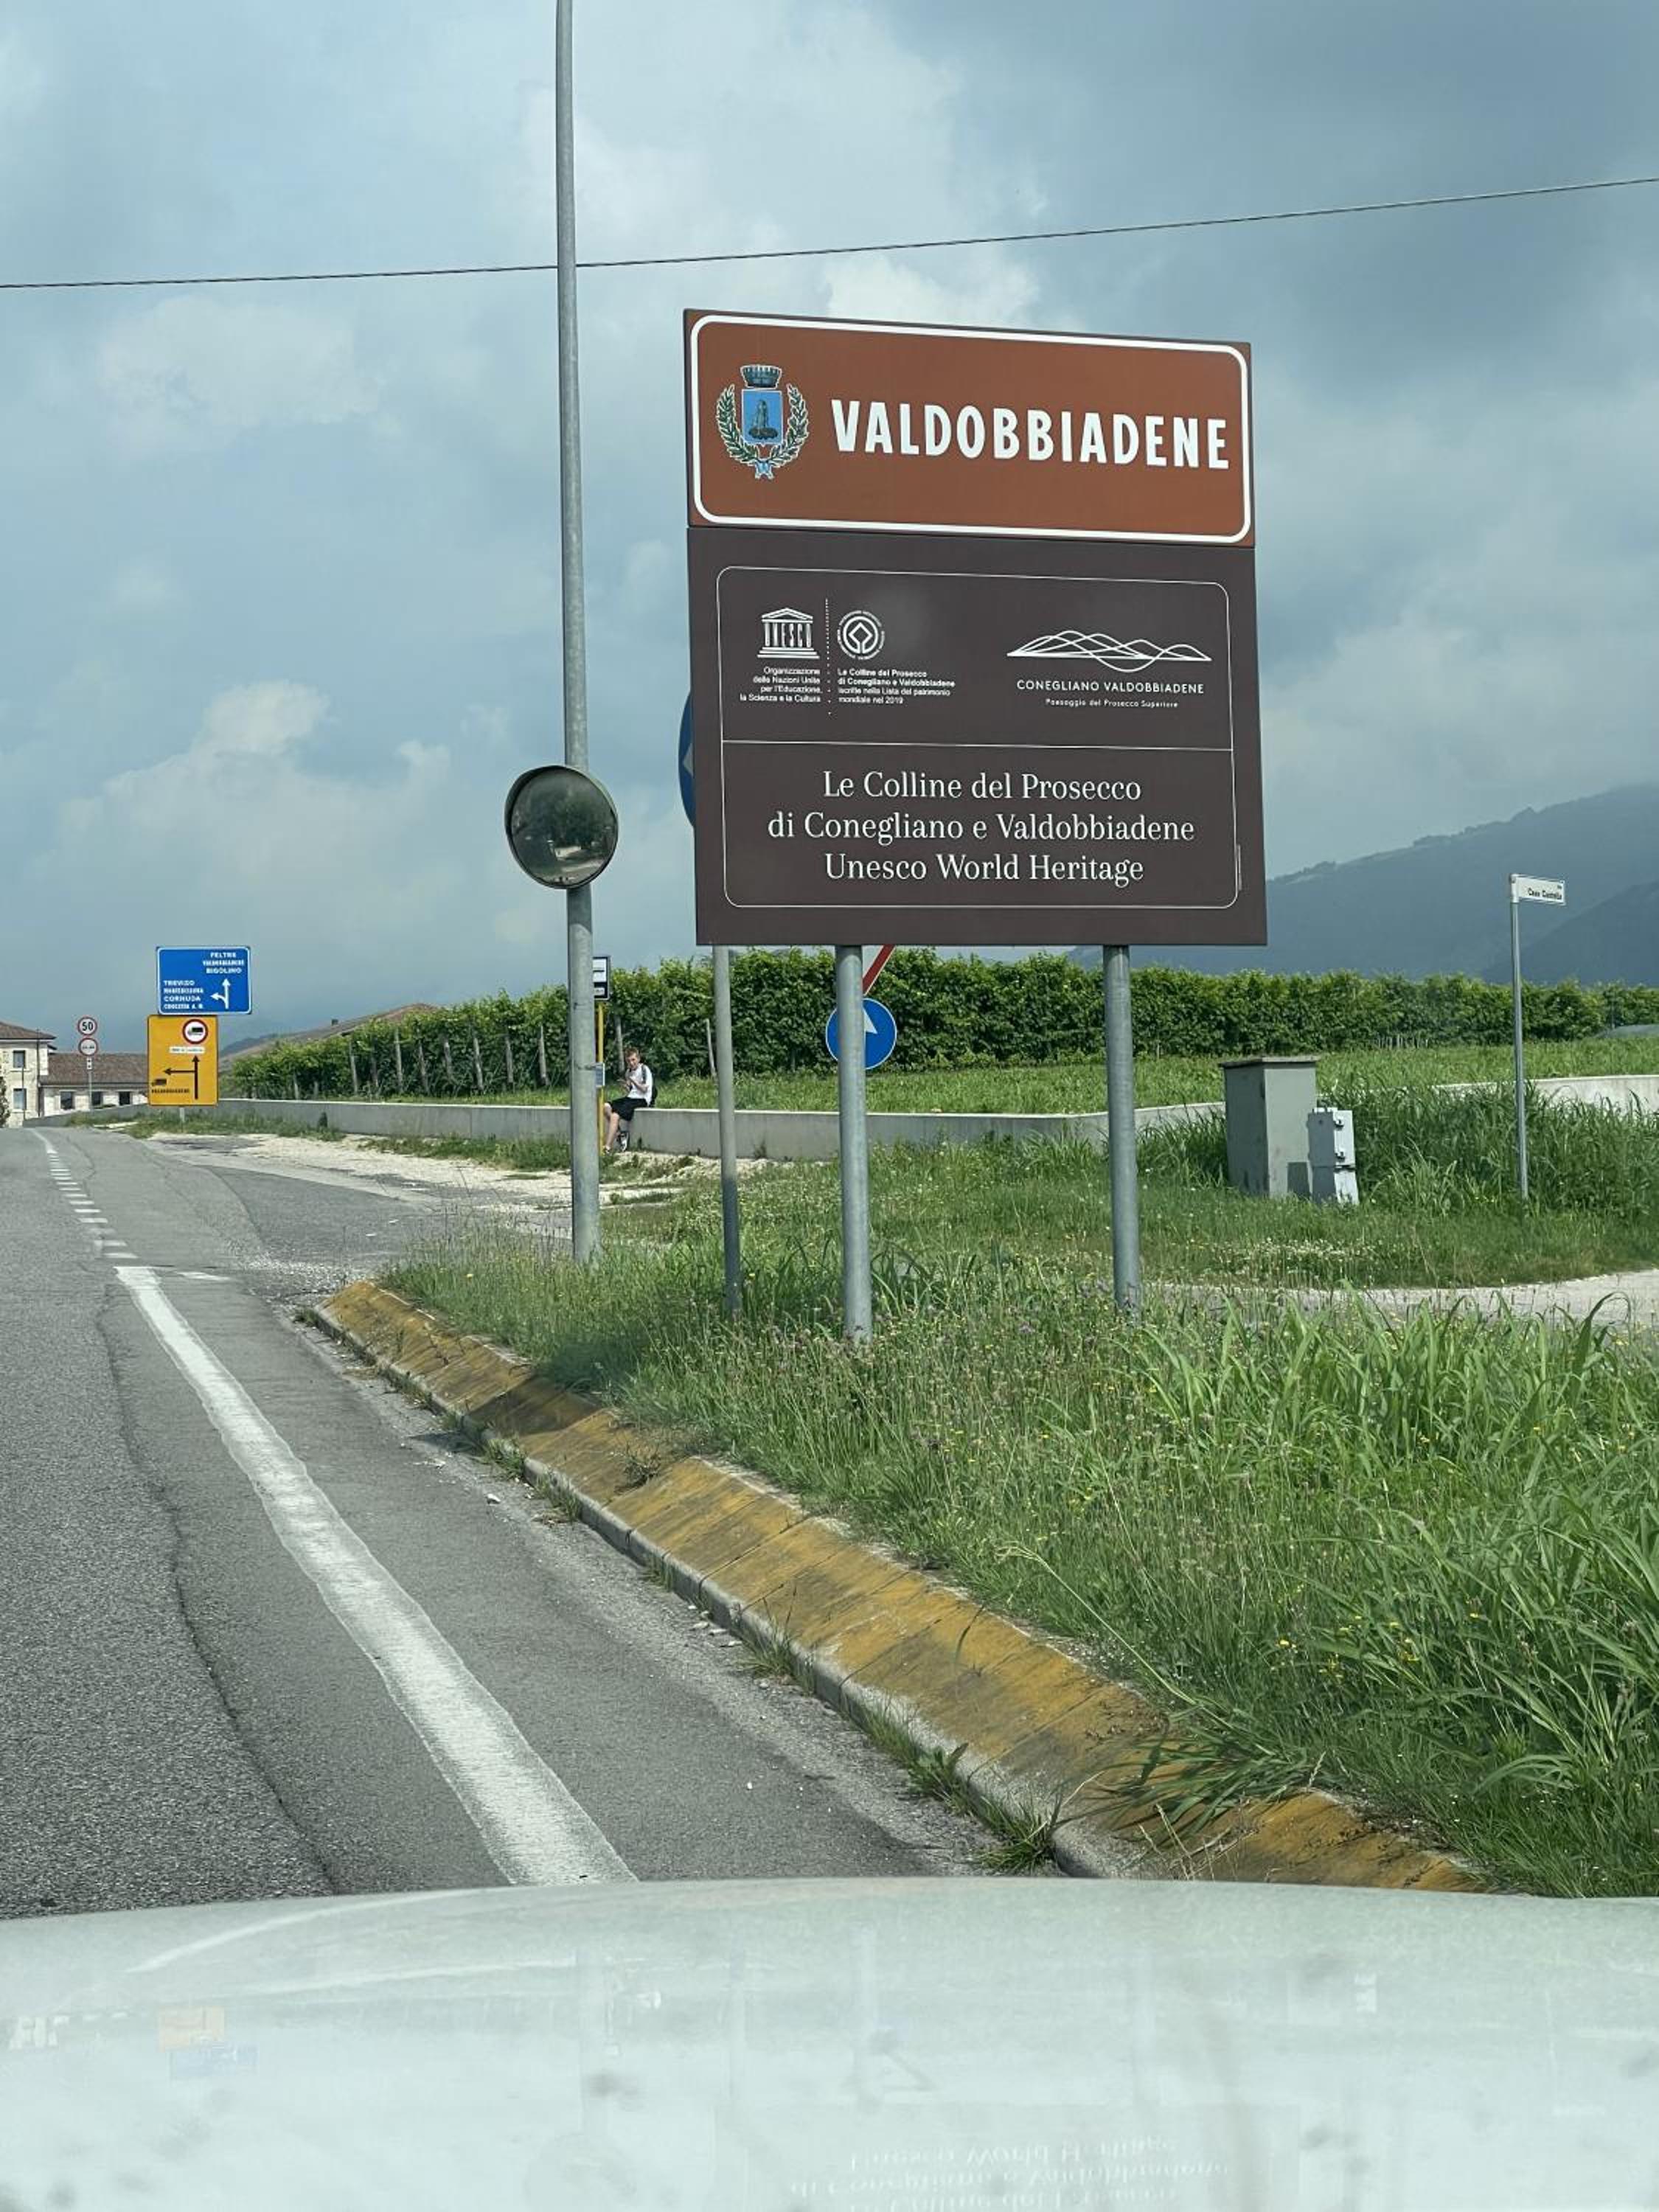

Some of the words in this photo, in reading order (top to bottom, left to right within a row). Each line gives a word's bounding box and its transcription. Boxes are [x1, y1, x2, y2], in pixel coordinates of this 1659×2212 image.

[832, 400, 1228, 468] VALDOBBIADENE
[847, 678, 891, 686] Conegliano
[900, 678, 955, 687] Valdobbiadene
[1017, 680, 1099, 691] CONEGLIANO
[1104, 682, 1203, 693] VALDOBBIADENE
[749, 693, 777, 701] Scienza
[1046, 698, 1085, 706] Paesaggio
[824, 771, 854, 796] Le
[864, 771, 961, 798] Colline
[972, 773, 1012, 798] del
[1022, 774, 1141, 799] Prosecco
[768, 811, 793, 838] di
[805, 813, 963, 846] Conegliano
[973, 821, 987, 839] e
[996, 814, 1194, 840] Valdobbiadene
[826, 854, 926, 879] Unesco
[936, 854, 1019, 879] World
[1030, 855, 1143, 888] Heritage
[82, 1022, 94, 1031] 50
